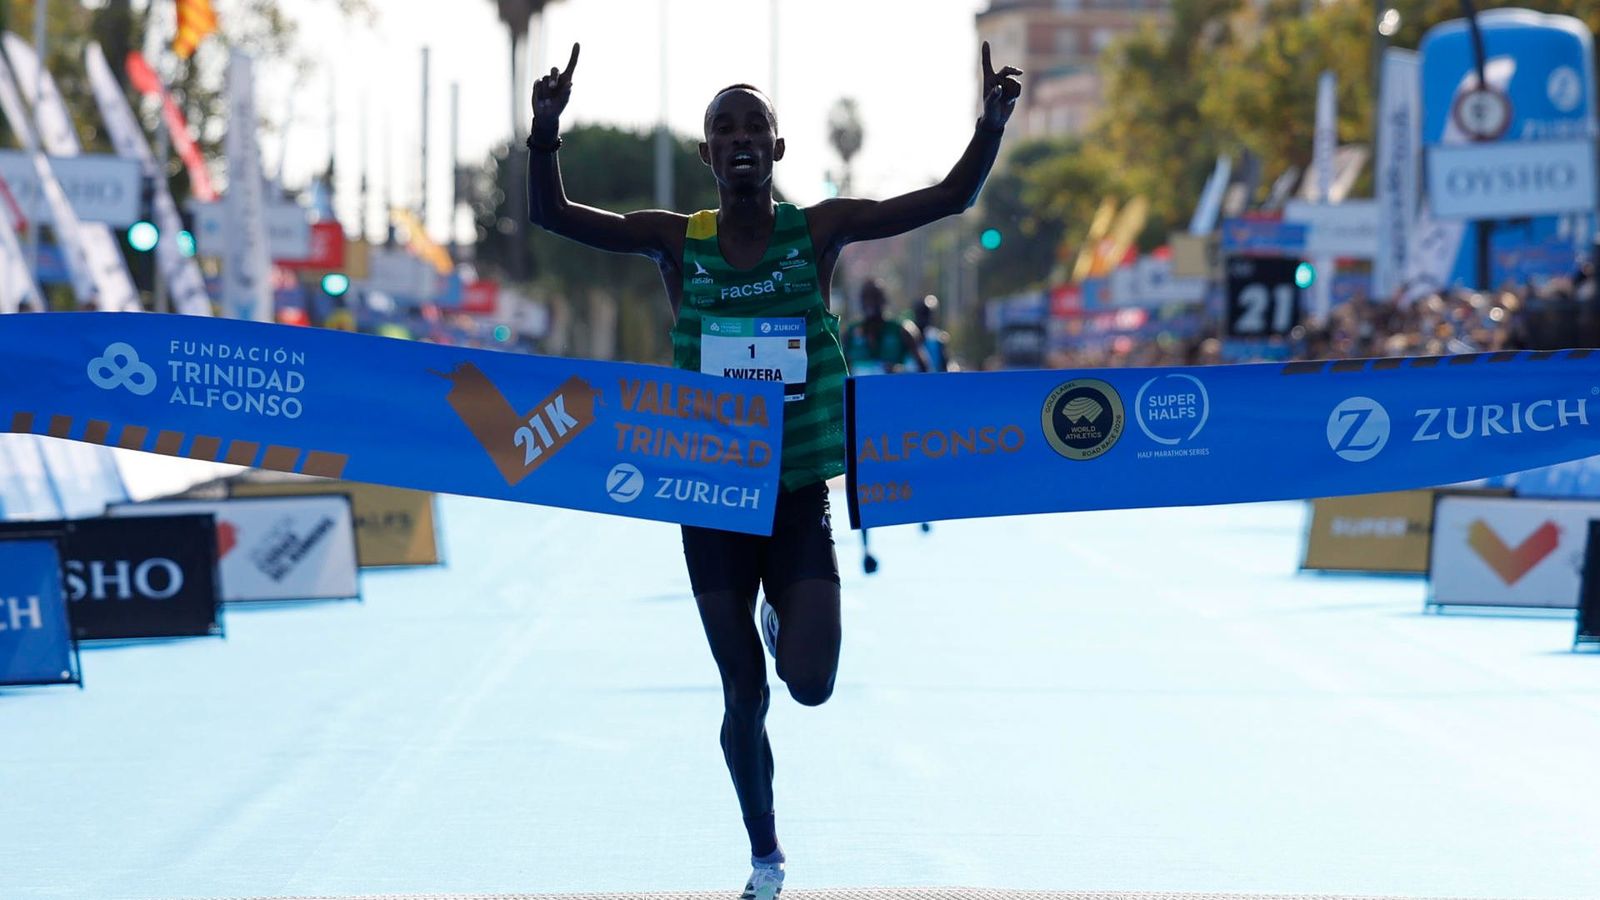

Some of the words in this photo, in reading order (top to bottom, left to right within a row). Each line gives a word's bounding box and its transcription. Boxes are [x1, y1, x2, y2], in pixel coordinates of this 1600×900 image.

[1446, 160, 1577, 198] OYSHO
[1235, 282, 1295, 333] 21
[774, 324, 799, 332] ZURICH
[170, 340, 306, 366] FUNDACIÓN
[748, 344, 756, 359] 1
[168, 361, 306, 394] TRINIDAD
[724, 368, 782, 381] KWIZERA
[1056, 383, 1075, 396] LABEL
[1148, 393, 1197, 408] SUPER
[169, 386, 303, 419] ALFONSO
[618, 378, 769, 428] VALENCIA
[1148, 406, 1197, 421] HALFS
[1070, 425, 1096, 433] WORLD
[1412, 398, 1589, 442] ZURICH
[613, 422, 772, 469] TRINIDAD
[858, 424, 1026, 464] ALFONSO
[1065, 431, 1103, 440] ATHLETICS
[1081, 446, 1102, 458] ROAD
[1100, 434, 1116, 451] RACE
[1137, 449, 1154, 459] HALF
[1153, 448, 1189, 458] MARATHON
[1188, 448, 1209, 457] SERIES
[654, 477, 761, 510] ZURICH
[858, 480, 913, 505] 2026
